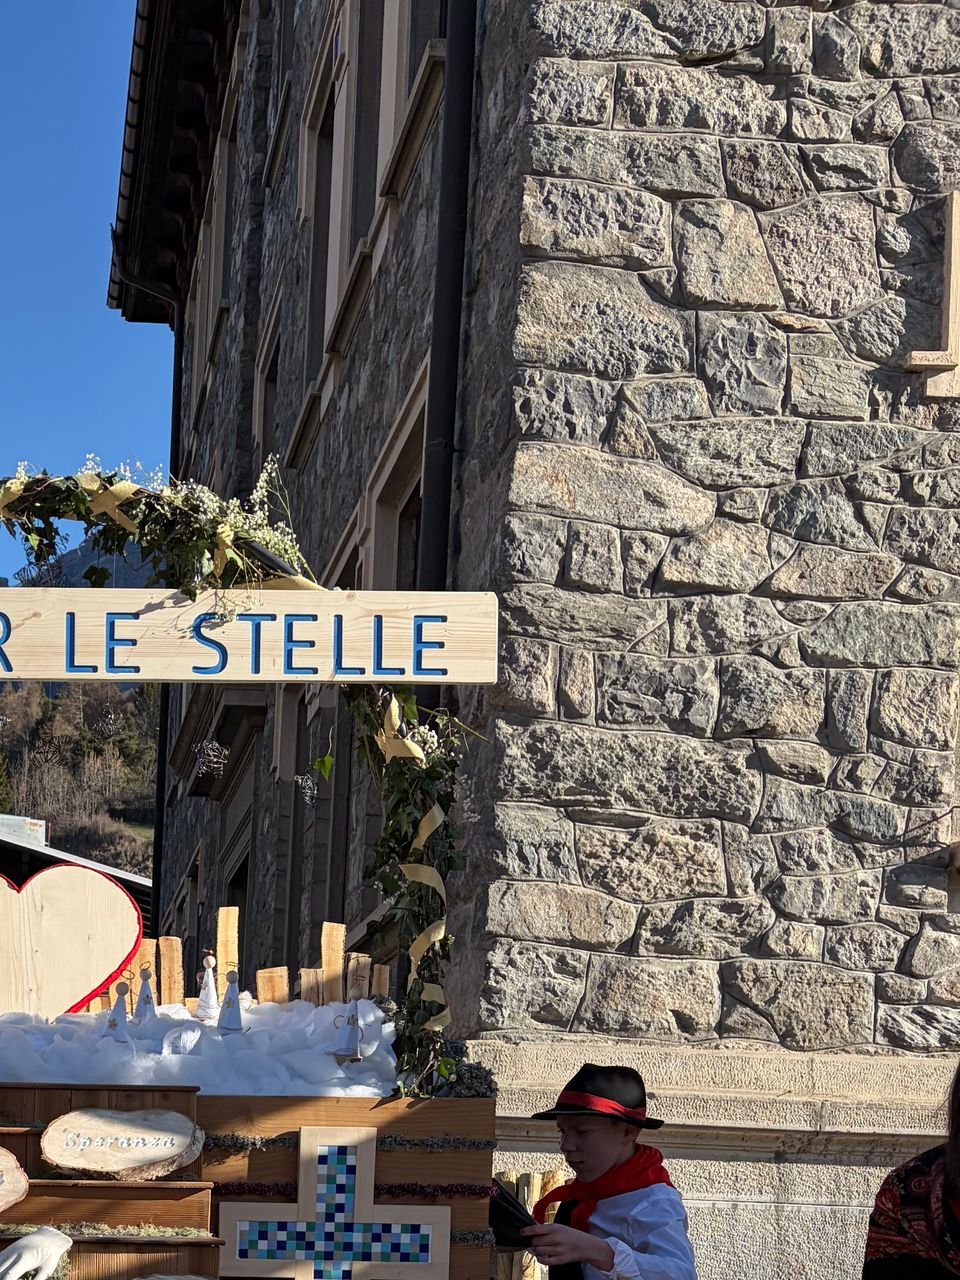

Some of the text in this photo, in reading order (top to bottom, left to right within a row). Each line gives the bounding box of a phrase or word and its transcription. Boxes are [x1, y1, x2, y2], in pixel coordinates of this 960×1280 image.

[65, 612, 141, 674] LE
[191, 613, 449, 676] STELLE
[63, 1131, 176, 1152] Speranza
